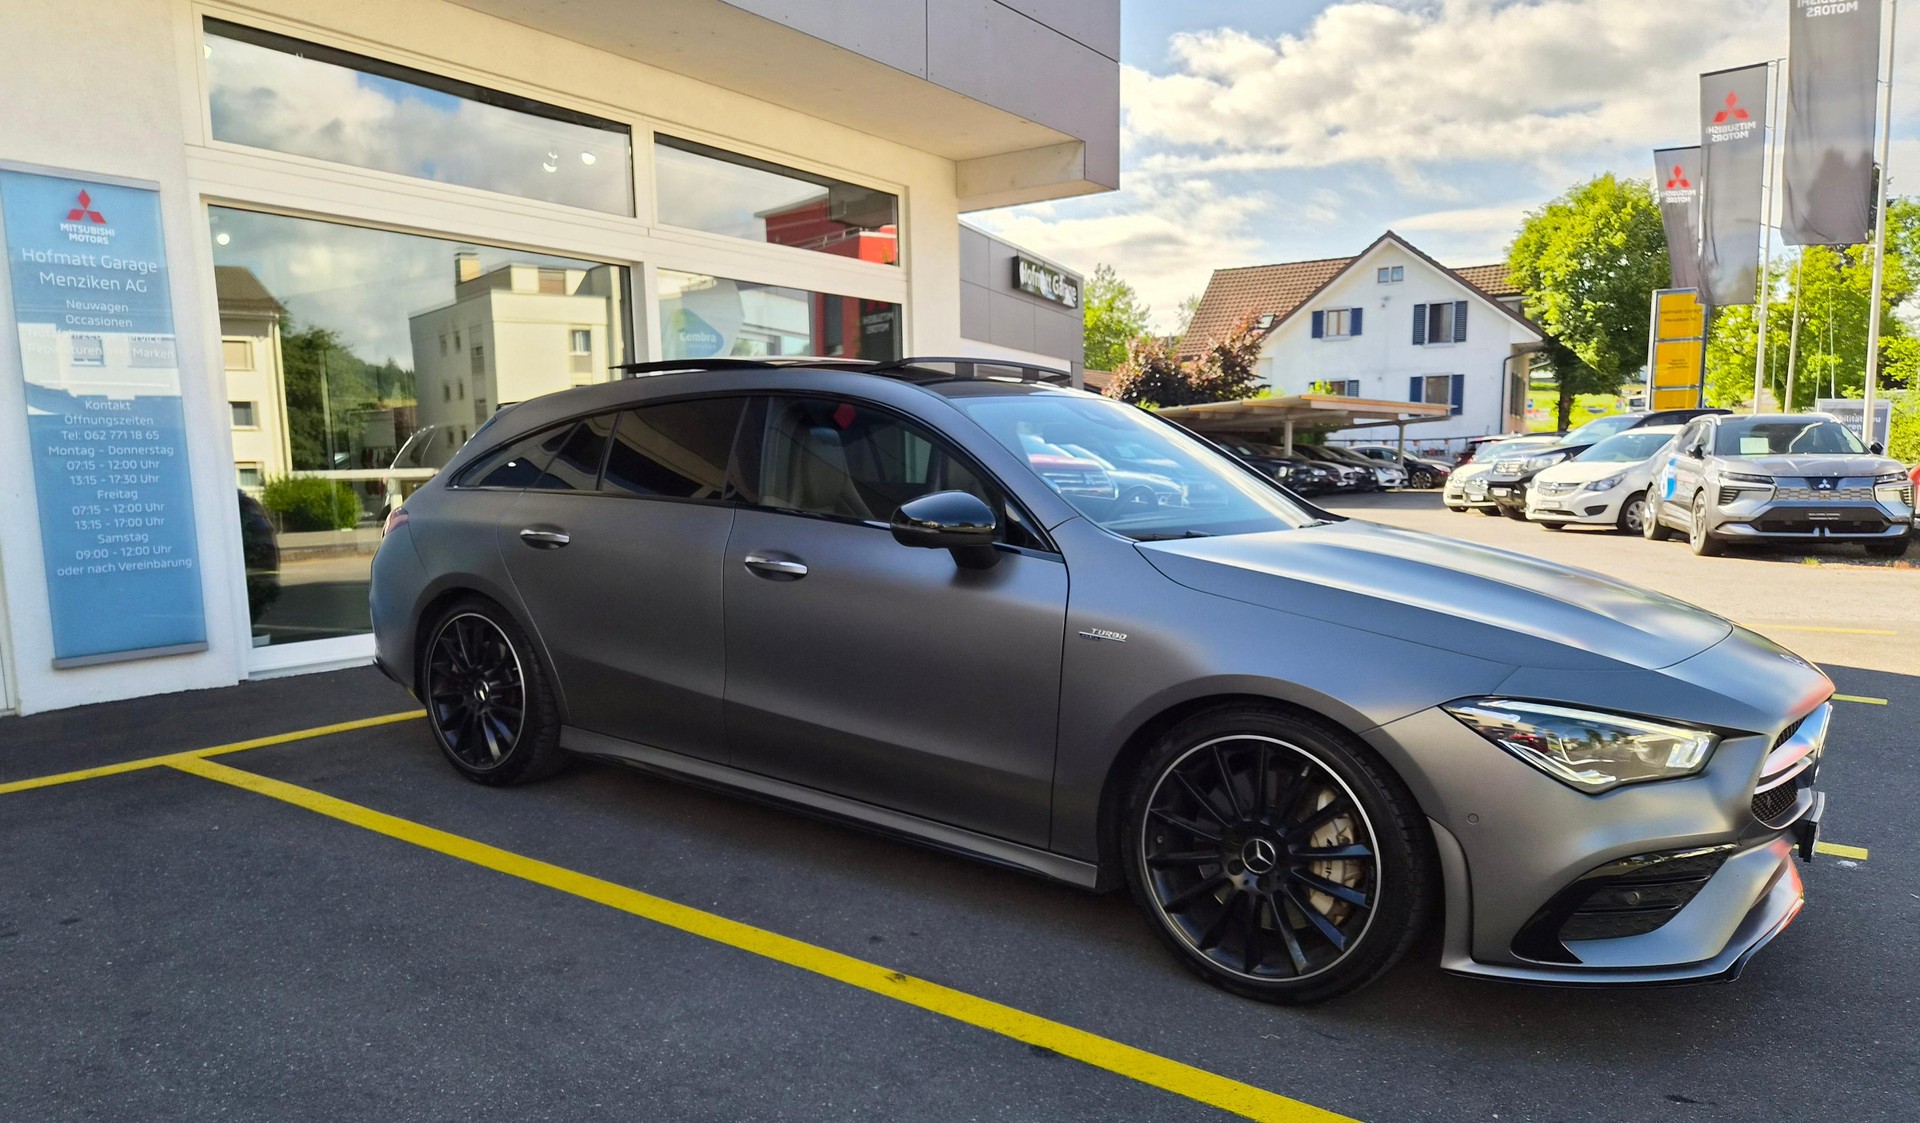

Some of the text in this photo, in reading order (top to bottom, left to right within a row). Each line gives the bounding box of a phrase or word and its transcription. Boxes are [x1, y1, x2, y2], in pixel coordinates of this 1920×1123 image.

[60, 223, 115, 236] MITSUBISHI
[69, 233, 109, 245] MOTORS
[22, 248, 158, 275] Hofmatt Garage
[39, 272, 147, 292] Menziken AG
[66, 300, 129, 314] Neuwagen
[65, 314, 133, 327] Occasionen
[133, 347, 175, 359] Marken
[85, 400, 131, 411] Kontakt
[64, 414, 154, 427] Öffnungszeiten
[84, 430, 106, 440] 062
[110, 430, 127, 440] 771
[130, 430, 143, 440] 18
[146, 430, 160, 440] 65
[48, 446, 95, 458] Montag
[108, 445, 174, 457] Donnerstag
[66, 461, 96, 471] 07:15
[108, 460, 137, 470] 12:00
[140, 460, 161, 469] Uhr
[70, 475, 97, 485] 13:15
[109, 475, 137, 485] 17:30
[140, 474, 160, 484] Uhr
[97, 490, 138, 502] Freitag
[72, 505, 101, 516] 07:15
[113, 503, 142, 514] 12:00
[145, 503, 165, 513] Uhr
[75, 520, 102, 530] 13:15
[114, 518, 142, 528] 17:00
[146, 517, 165, 527] Uhr
[98, 533, 149, 544] Samstag
[76, 549, 109, 560] 09:00
[121, 546, 150, 557] 12:00
[153, 545, 173, 555] Uhr
[57, 558, 193, 576] oder nach Vereinbarung
[1092, 627, 1128, 640] TURBO
